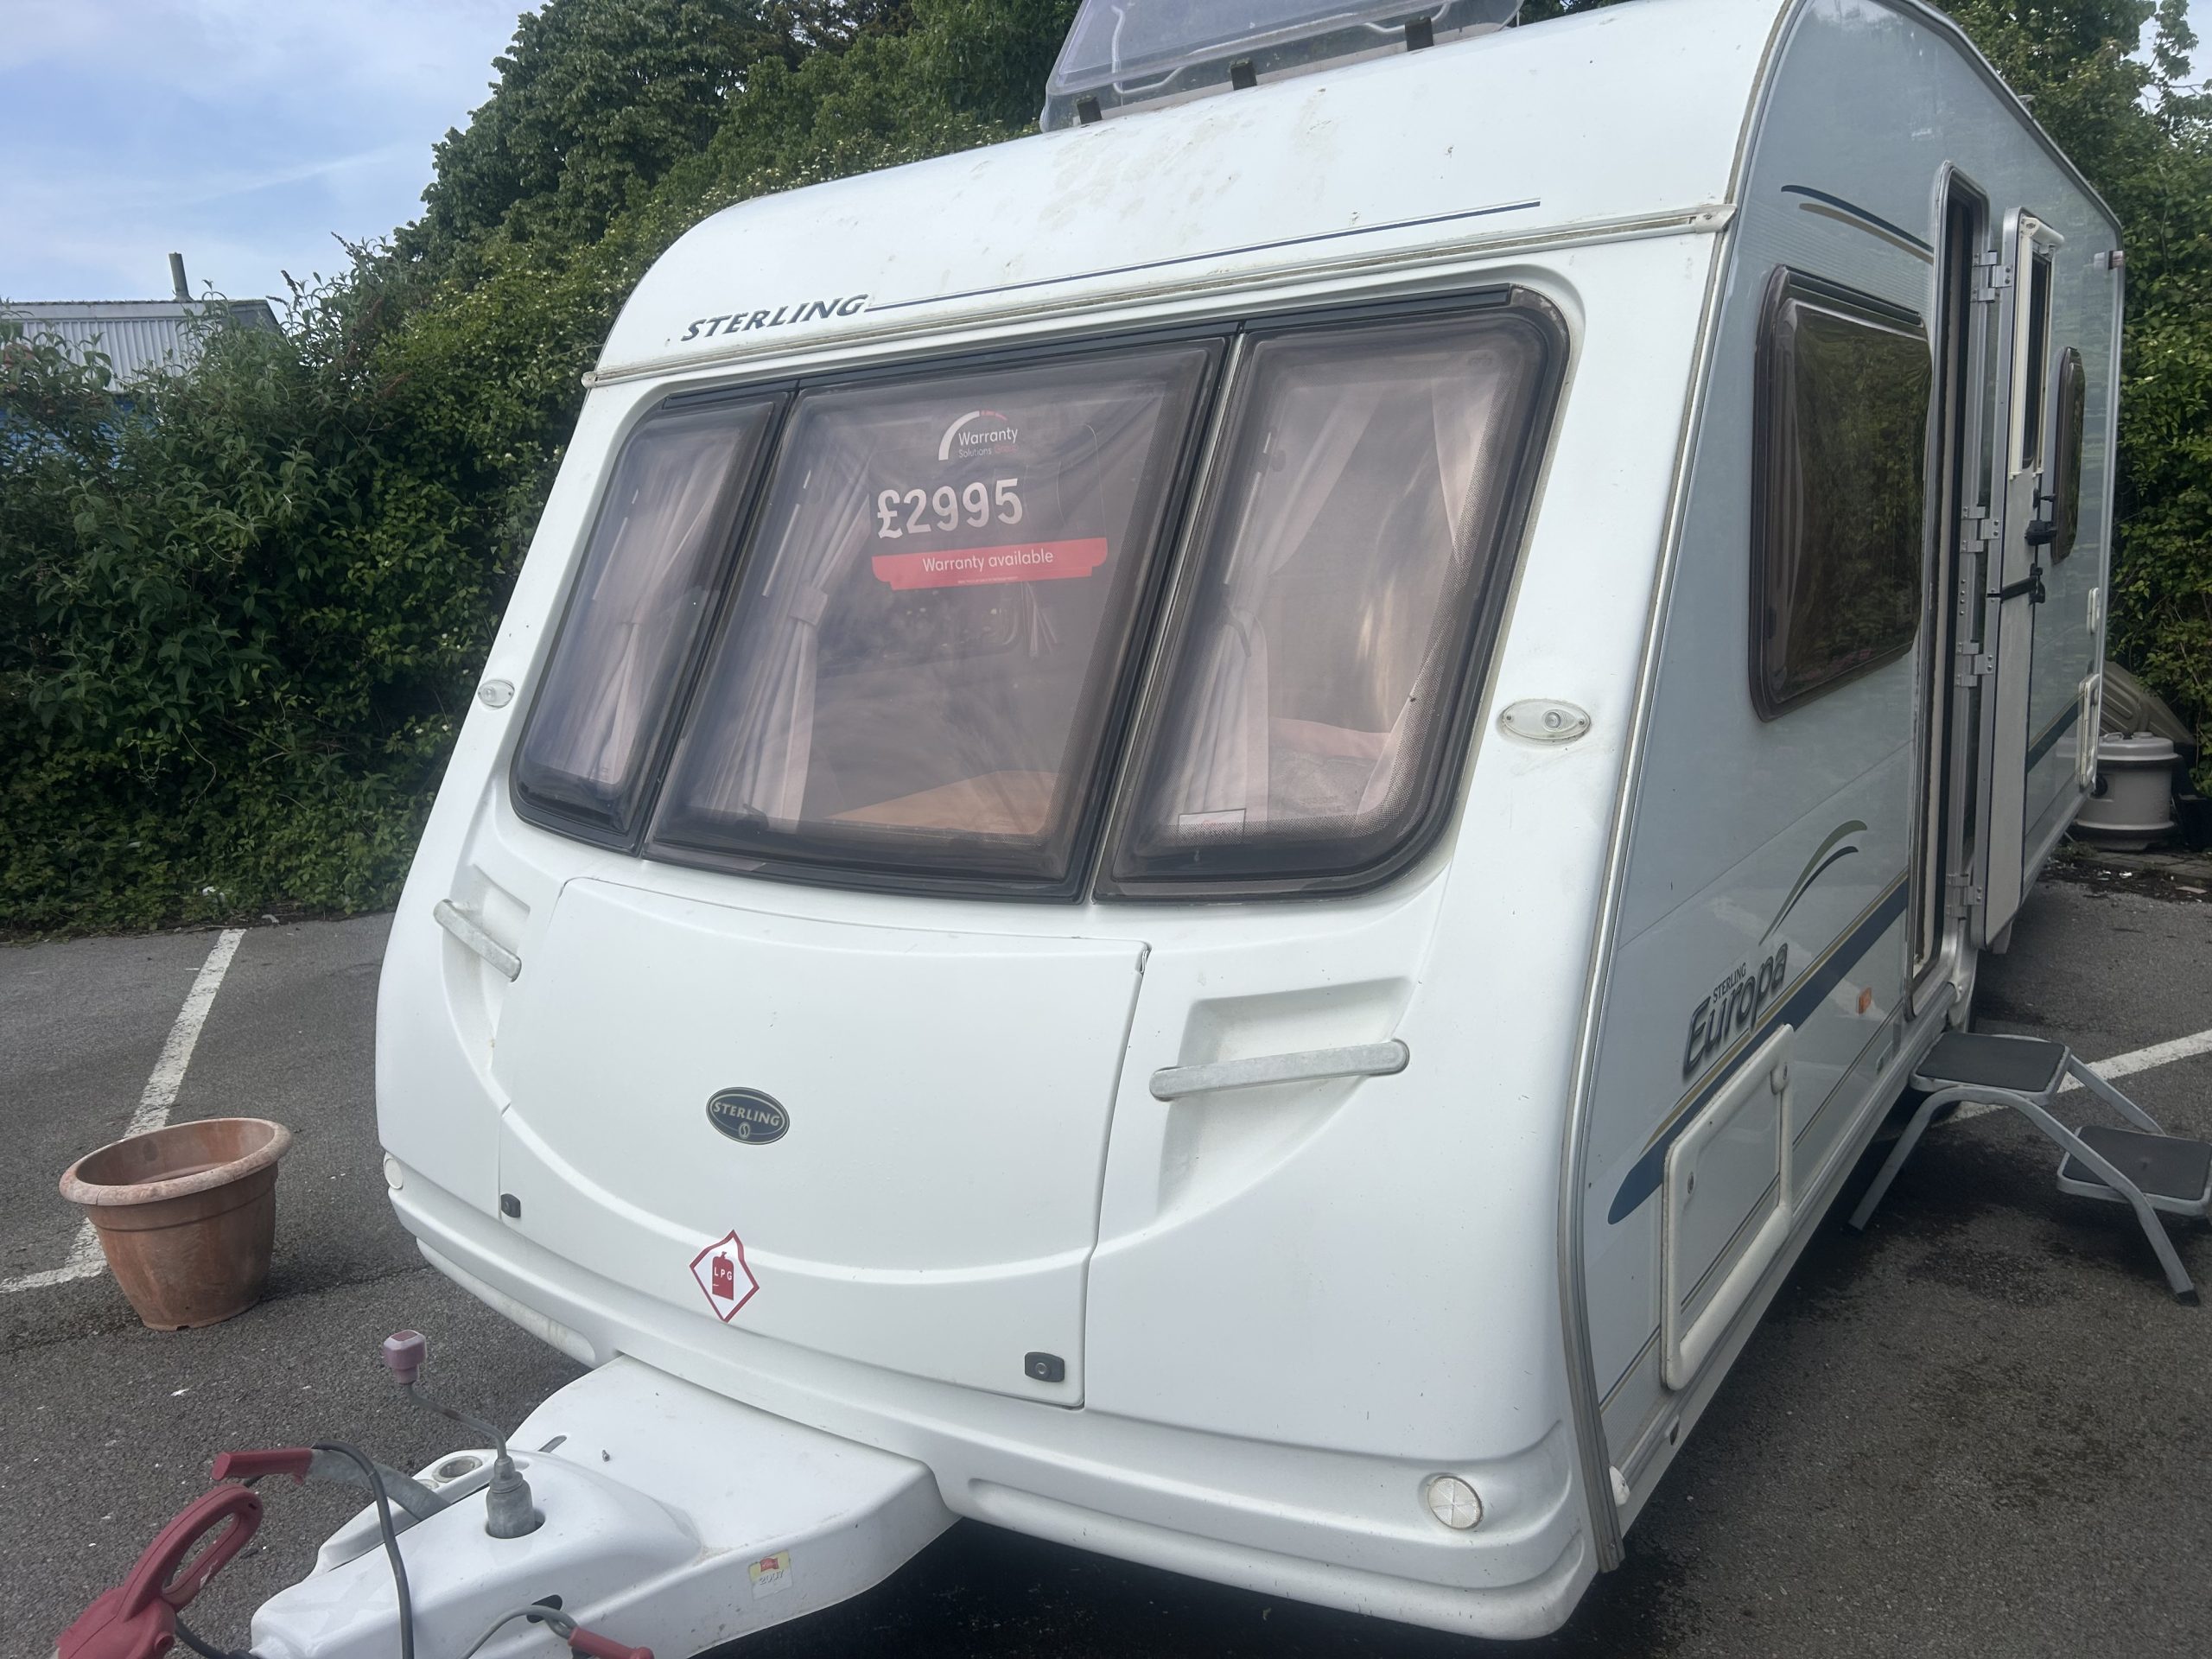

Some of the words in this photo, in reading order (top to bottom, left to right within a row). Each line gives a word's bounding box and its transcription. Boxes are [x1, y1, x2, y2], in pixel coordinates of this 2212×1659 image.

[681, 294, 868, 341] STERLING
[958, 427, 1019, 447] Warranty
[958, 446, 993, 458] Solutions
[877, 478, 1023, 539] £2995
[922, 555, 985, 572] Warranty
[988, 548, 1053, 567] available
[1713, 962, 1746, 1003] STERLING
[1683, 943, 1789, 1075] Europa
[713, 1101, 780, 1127] STERLING
[714, 1267, 733, 1281] LPG
